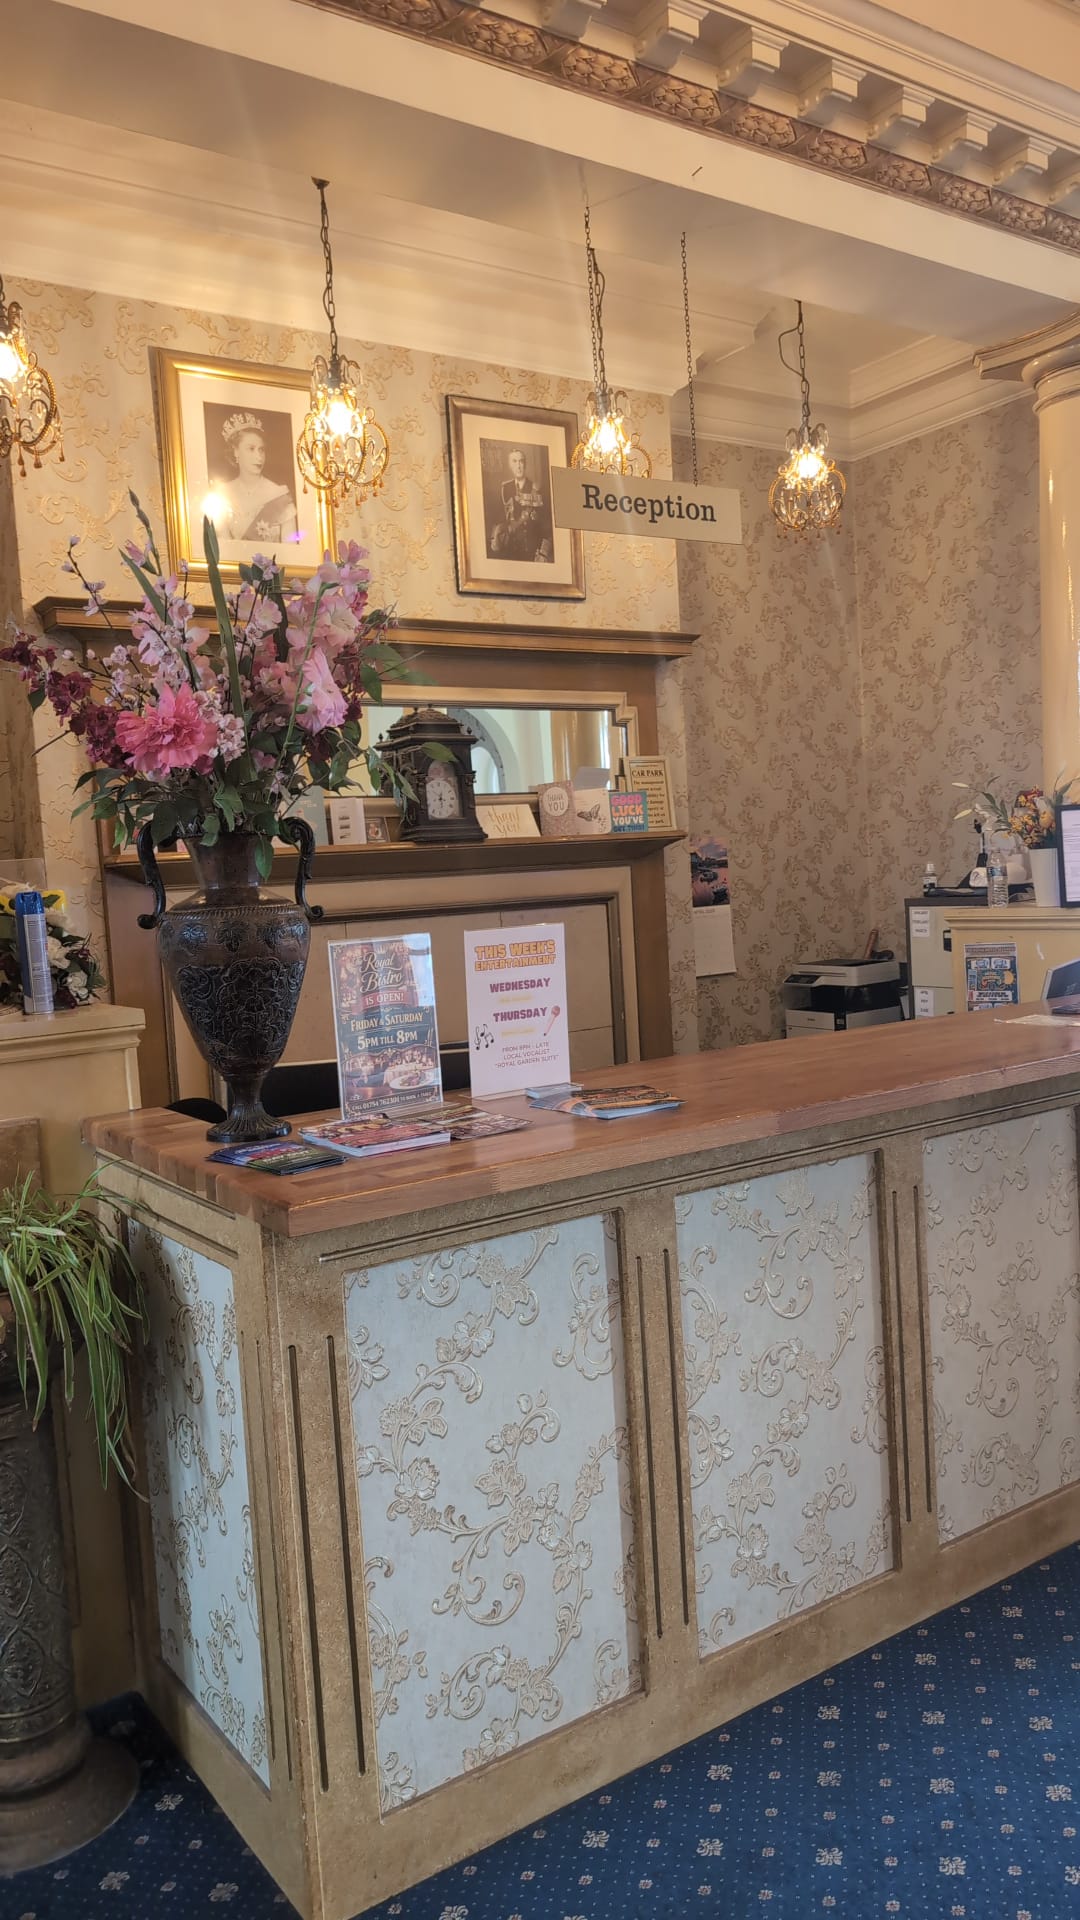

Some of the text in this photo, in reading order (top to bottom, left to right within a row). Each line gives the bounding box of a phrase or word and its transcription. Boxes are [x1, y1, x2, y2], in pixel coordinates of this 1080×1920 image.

[581, 484, 717, 523] Reception
[548, 802, 565, 811] YOU
[611, 794, 643, 806] GOOD
[612, 804, 644, 817] LUCK
[613, 815, 645, 825] YOU'VE
[474, 939, 556, 960] THIS WEEK'S
[360, 952, 403, 973] Royal
[474, 954, 556, 971] ENTERTAINMENT
[360, 970, 403, 993] Bistro
[489, 977, 551, 993] WEDNESDAY
[365, 993, 404, 1006] IS OPEN!
[493, 1006, 548, 1022] THURSDAY
[350, 1018, 380, 1032] FRIDAY
[385, 1013, 424, 1026] SATURDAY
[357, 1030, 418, 1050] 5PM TILL 8PM
